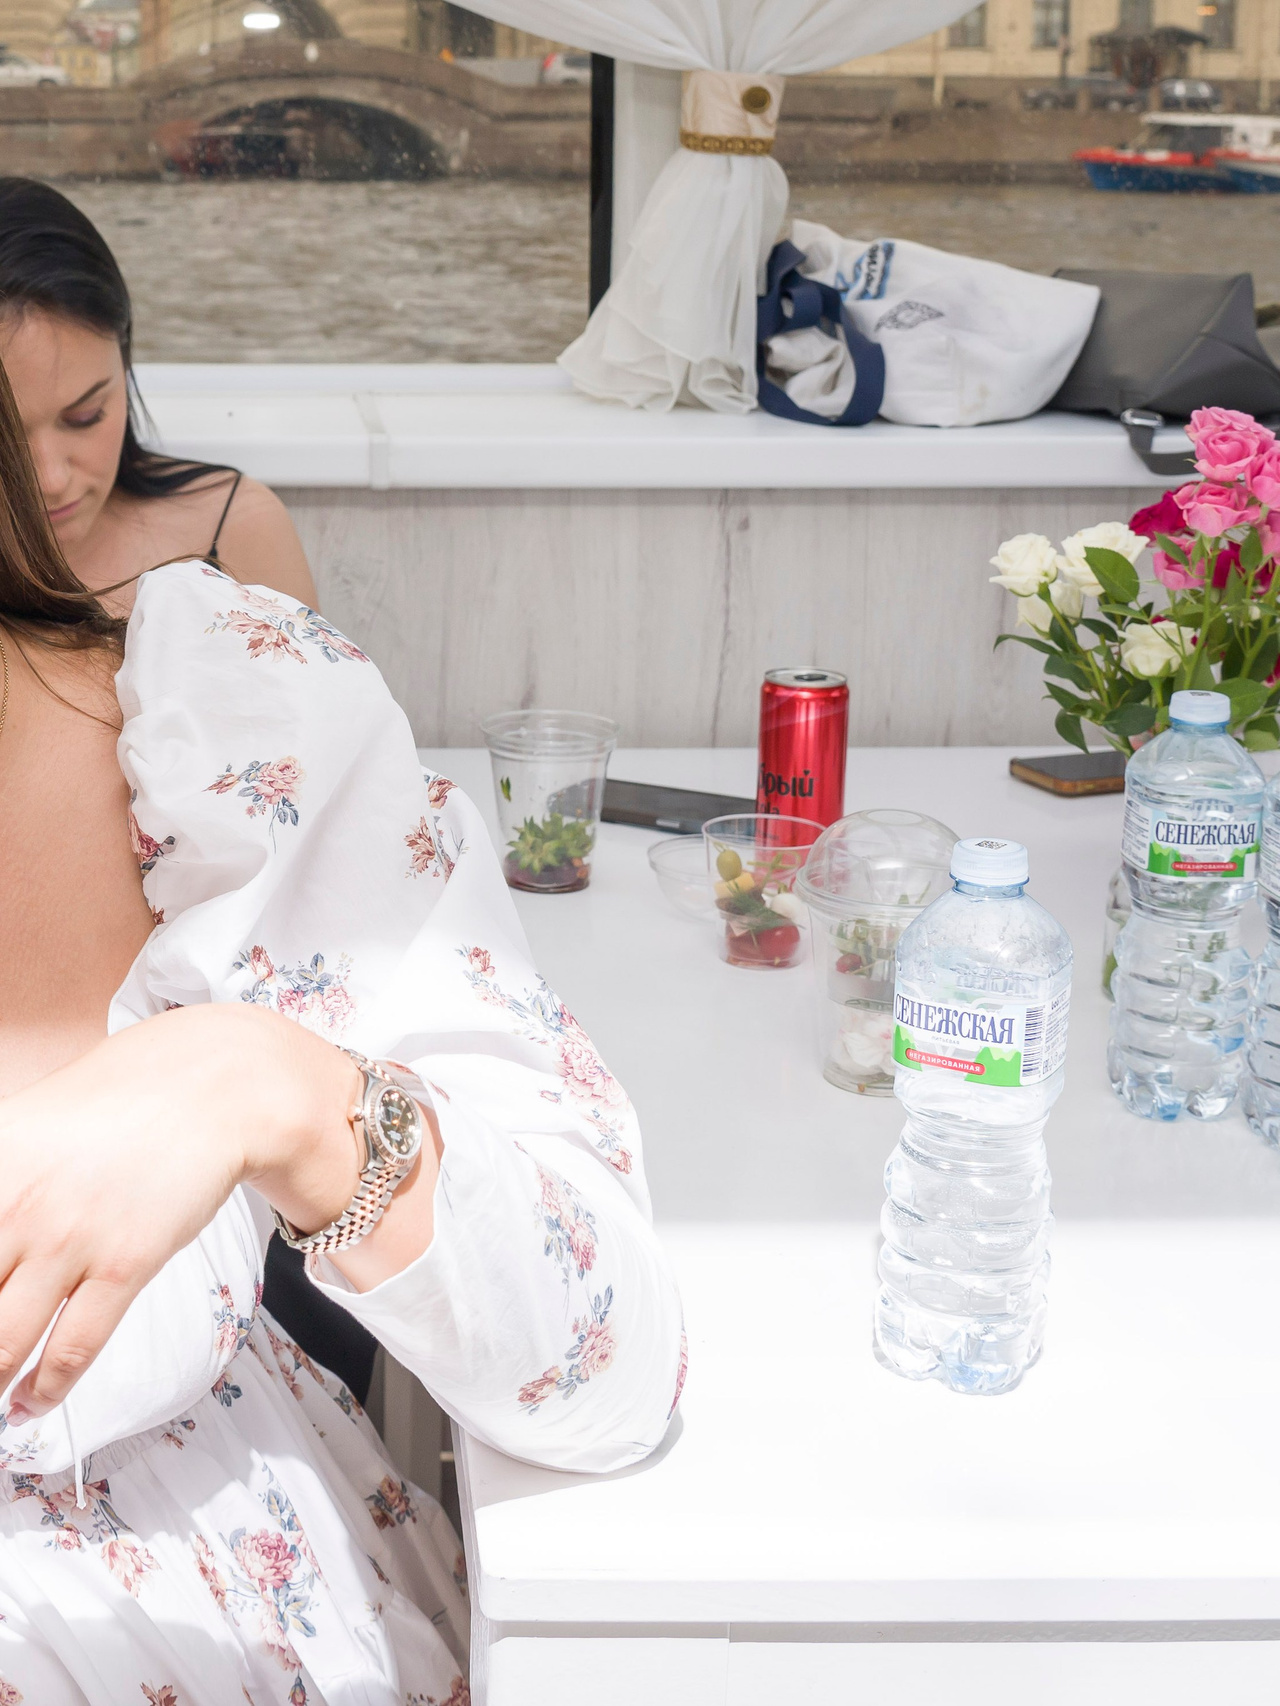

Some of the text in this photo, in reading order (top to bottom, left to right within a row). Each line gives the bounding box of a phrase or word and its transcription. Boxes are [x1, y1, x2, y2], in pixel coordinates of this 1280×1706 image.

[1155, 820, 1256, 846] СЕНЕЖСКАЯ
[895, 993, 1016, 1045] СЕНЕЖСКАЯ
[908, 1051, 981, 1073] НЕГАЗИРОВАННАЯ
